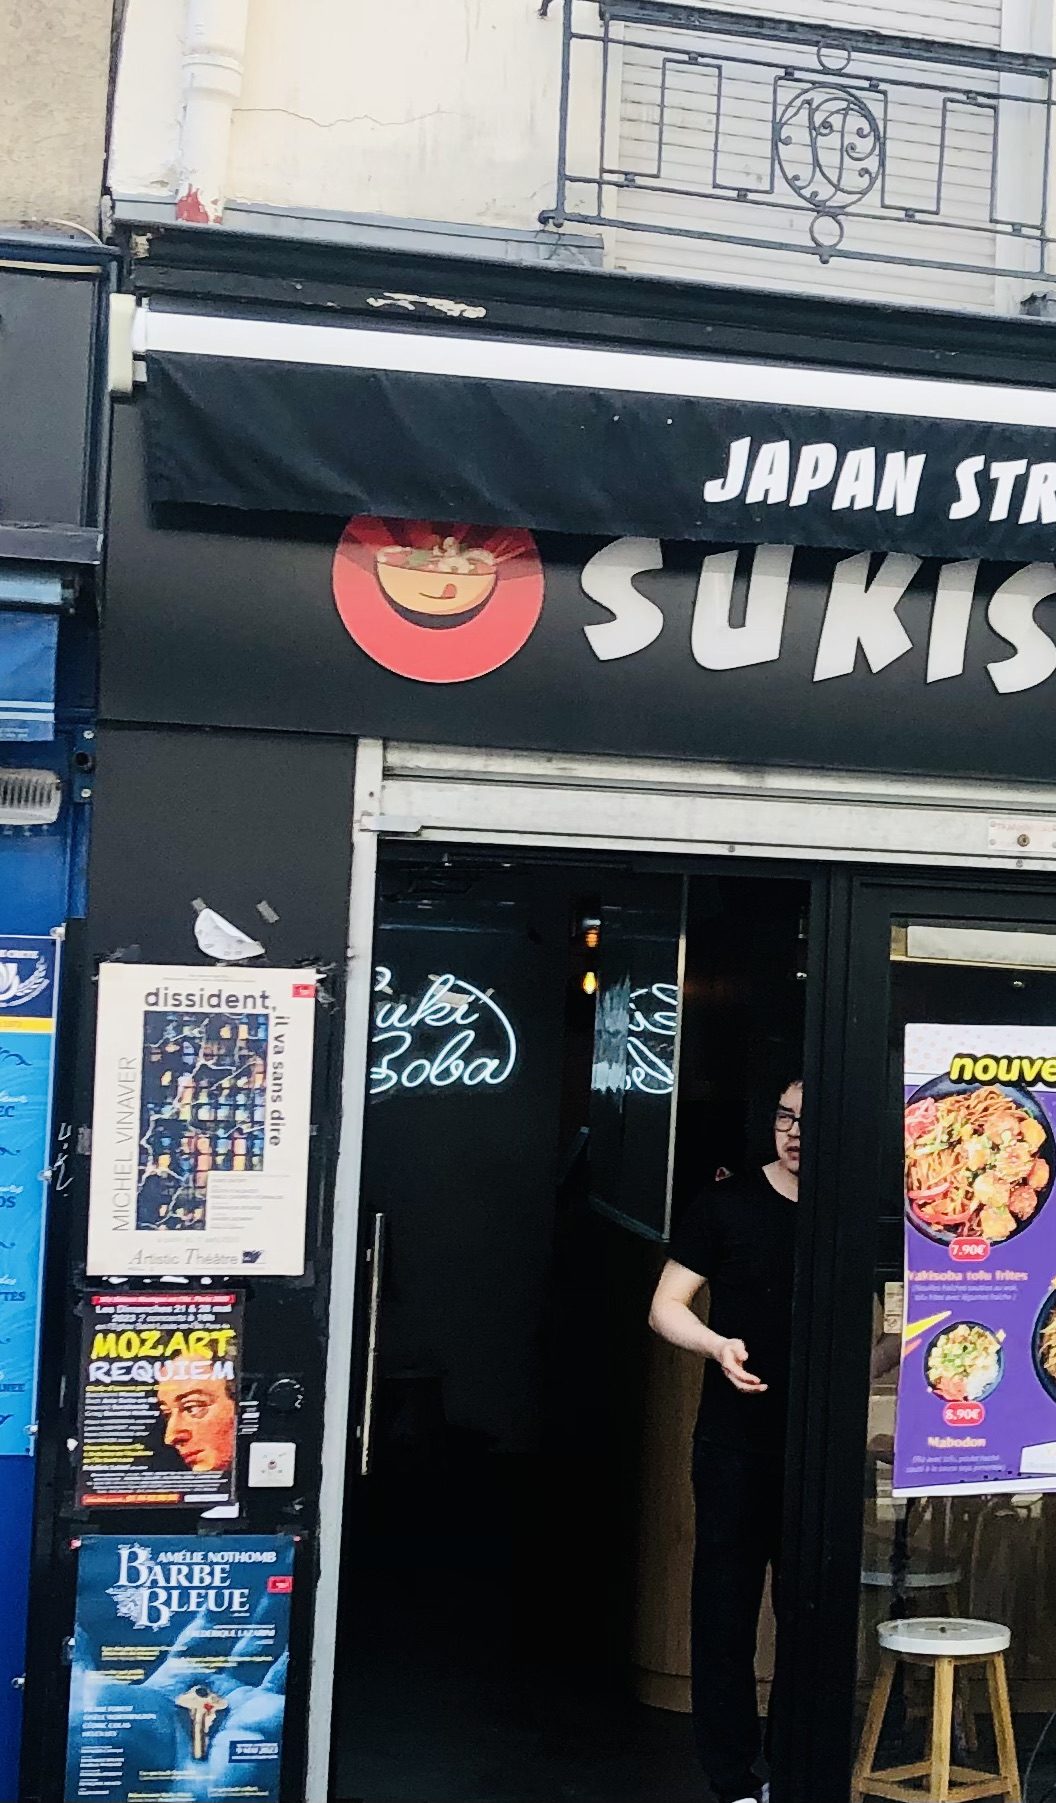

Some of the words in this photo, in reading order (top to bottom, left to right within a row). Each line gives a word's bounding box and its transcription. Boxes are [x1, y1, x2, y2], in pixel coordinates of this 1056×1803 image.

[702, 436, 927, 517] JAPAN
[144, 987, 277, 1012] dissident,
[272, 1034, 287, 1055] va
[271, 1062, 286, 1103] sans
[116, 1057, 137, 1145] VINAVER
[268, 1111, 287, 1147] dire
[112, 1152, 134, 1231] MICHEL
[951, 1244, 986, 1256] 7.90€
[90, 1329, 236, 1359] MOZART
[88, 1360, 235, 1384] REQUIEM
[114, 1545, 231, 1587] BARBE
[157, 1549, 207, 1563] AMÉLIE
[207, 1551, 278, 1564] NOTHOMB
[134, 1588, 250, 1628] BLEUE
